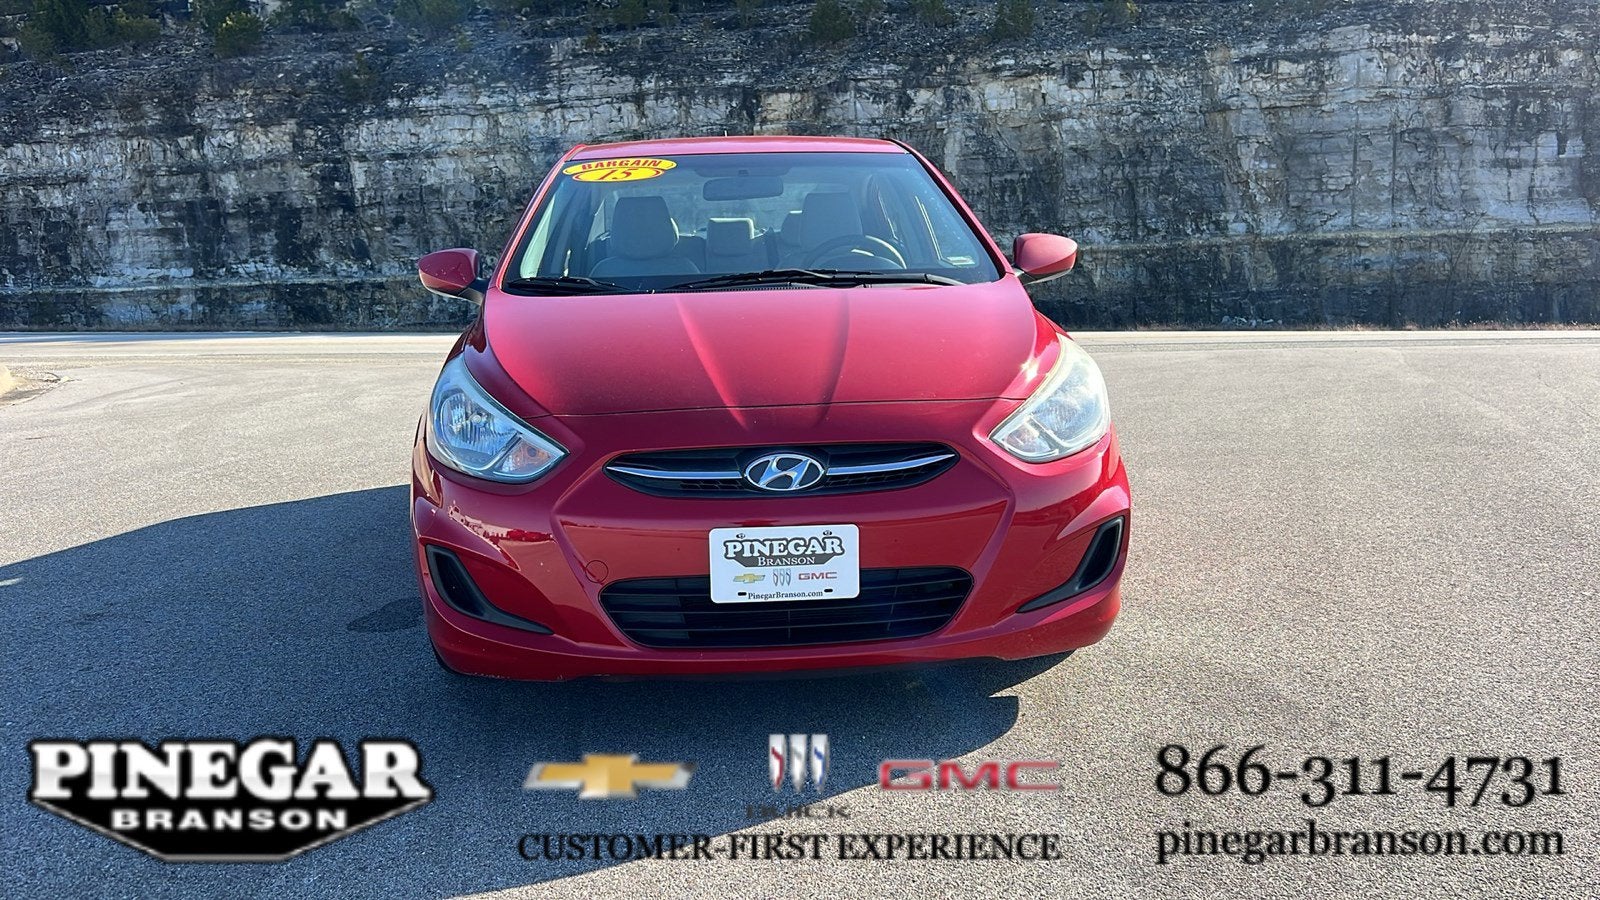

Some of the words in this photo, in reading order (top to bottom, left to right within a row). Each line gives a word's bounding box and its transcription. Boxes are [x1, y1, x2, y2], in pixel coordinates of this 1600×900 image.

[581, 159, 661, 170] BARGAIN
[598, 168, 638, 180] 15
[724, 536, 845, 559] PINEGAR
[757, 556, 816, 567] BRANSON
[798, 571, 838, 581] GMC
[748, 591, 824, 601] PinegarBranson.com
